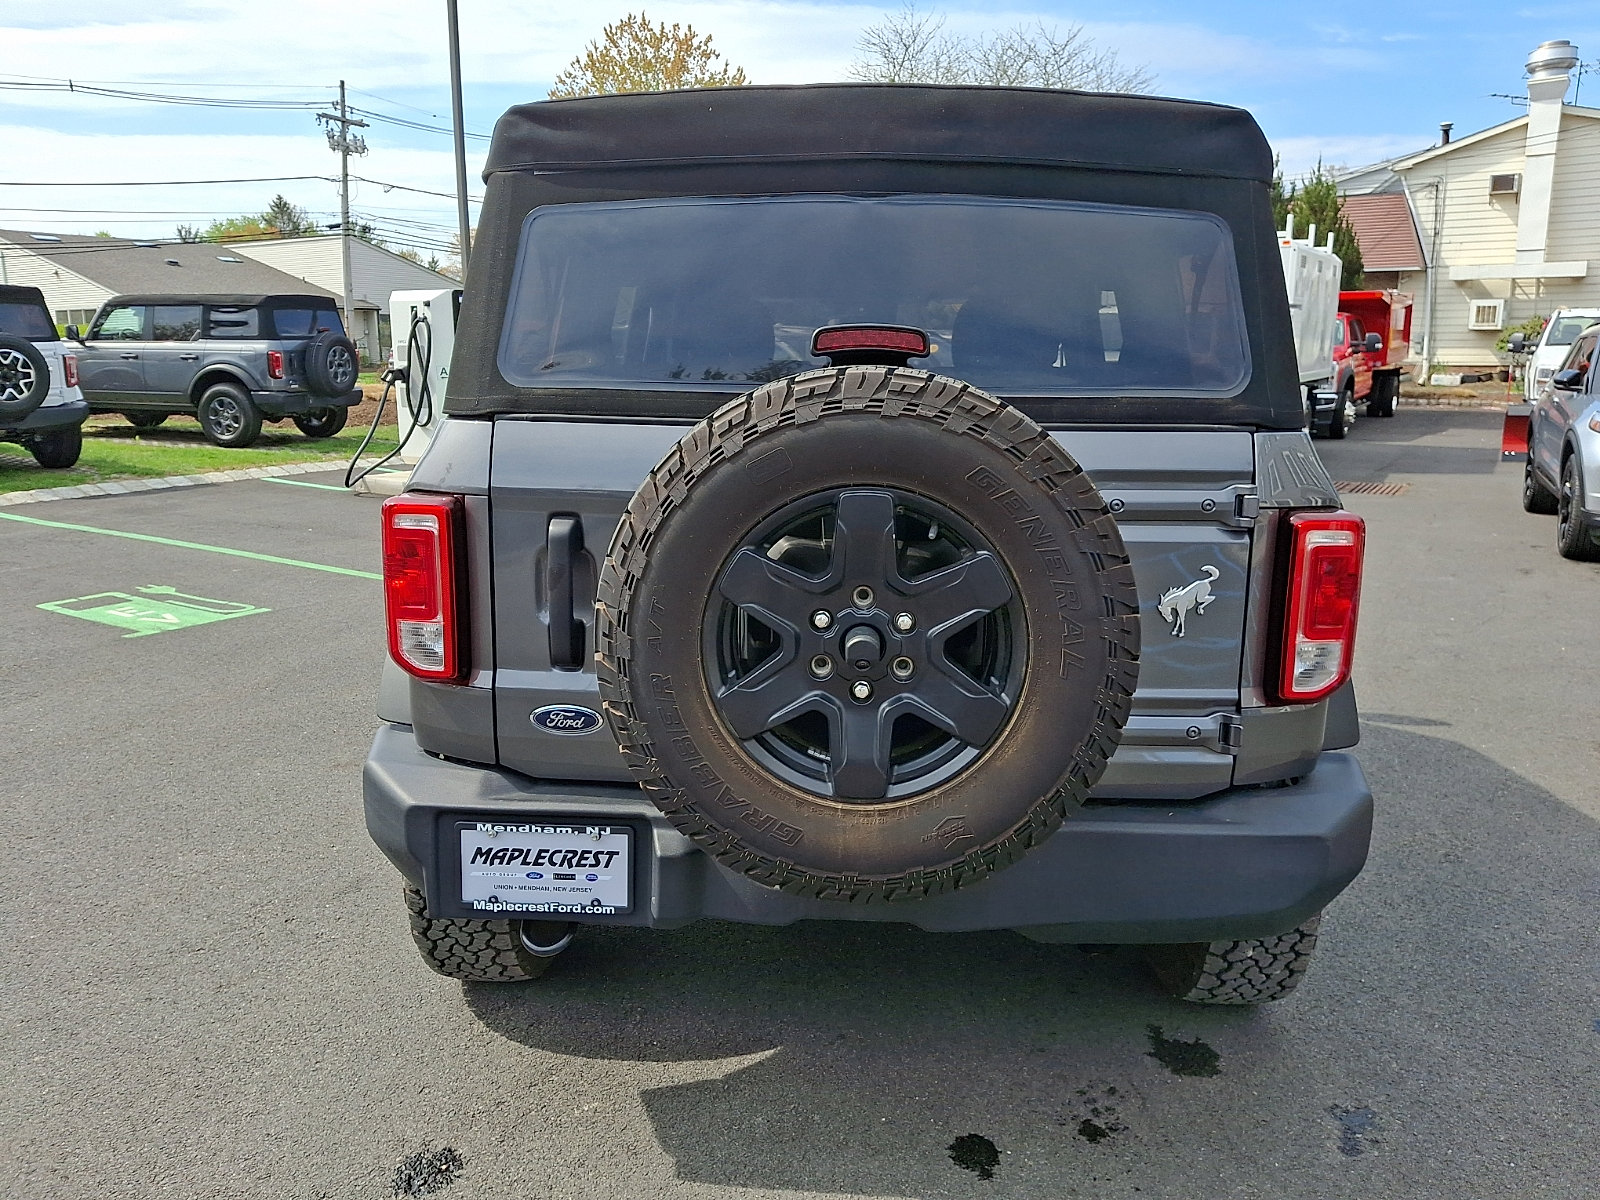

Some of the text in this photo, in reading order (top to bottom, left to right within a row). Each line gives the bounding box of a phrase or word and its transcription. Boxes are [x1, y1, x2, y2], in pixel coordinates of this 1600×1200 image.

[964, 464, 1088, 680] GENERAL
[546, 710, 585, 728] Ford
[648, 672, 805, 847] GRABBER
[476, 823, 611, 836] Mendham, NJ
[470, 847, 620, 869] MAPLECREST
[473, 899, 616, 915] MaplecrestFord.com
